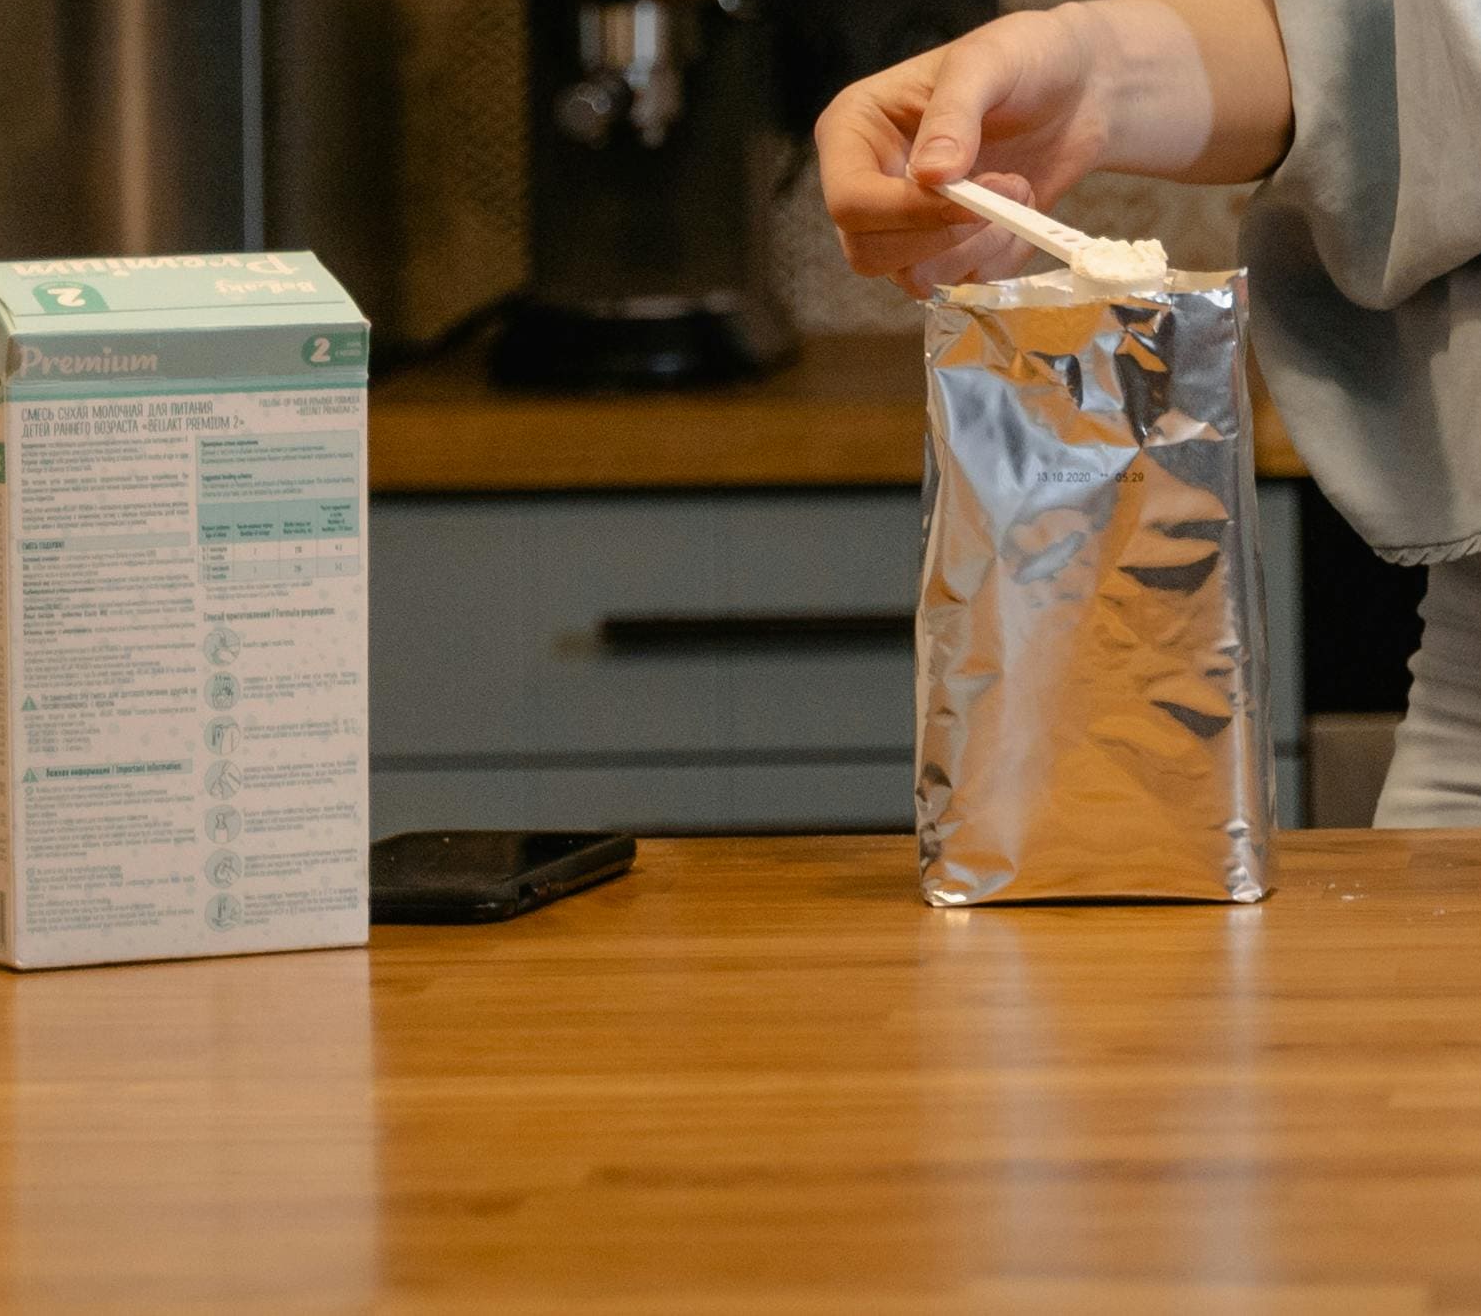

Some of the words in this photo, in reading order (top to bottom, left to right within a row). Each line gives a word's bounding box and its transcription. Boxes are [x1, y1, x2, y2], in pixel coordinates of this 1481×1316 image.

[19, 345, 158, 378] Premium
[310, 337, 331, 363] 2
[21, 407, 55, 422] СМЕСЬ
[57, 406, 89, 420] СУХАЯ
[92, 404, 143, 418] МОЛОЧНАЯ
[148, 403, 168, 417] ДЛЯ
[170, 401, 213, 416] ПИТАНИЯ
[22, 422, 51, 438] ДЕТЕЙ
[54, 421, 91, 436] РАННЕГО
[94, 419, 139, 434] ВОЗРАСТА
[185, 416, 230, 431] PREMIUM
